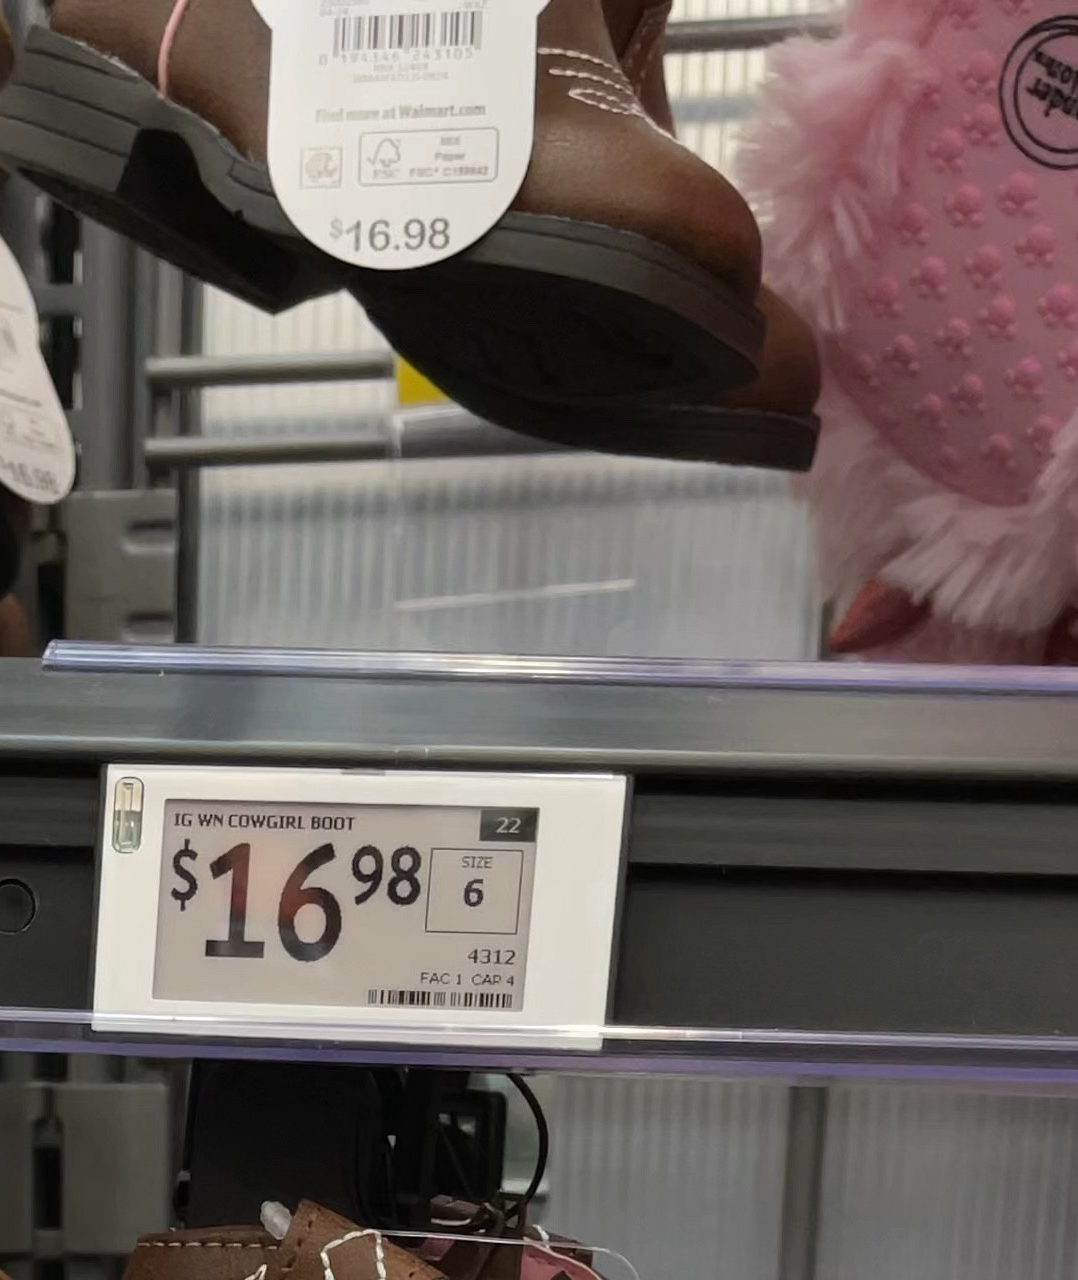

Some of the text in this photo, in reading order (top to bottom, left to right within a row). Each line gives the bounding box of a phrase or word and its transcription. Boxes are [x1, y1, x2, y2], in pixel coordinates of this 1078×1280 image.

[399, 104, 486, 119] Walmart.com
[329, 217, 450, 252] $16.98
[174, 813, 357, 832] IG WN COWGIRL BOOT
[496, 817, 521, 834] 22
[461, 855, 493, 870] SIZE
[463, 878, 485, 908] 6
[467, 949, 516, 966] 4312
[421, 971, 515, 988] FAC 1 CAP 4
